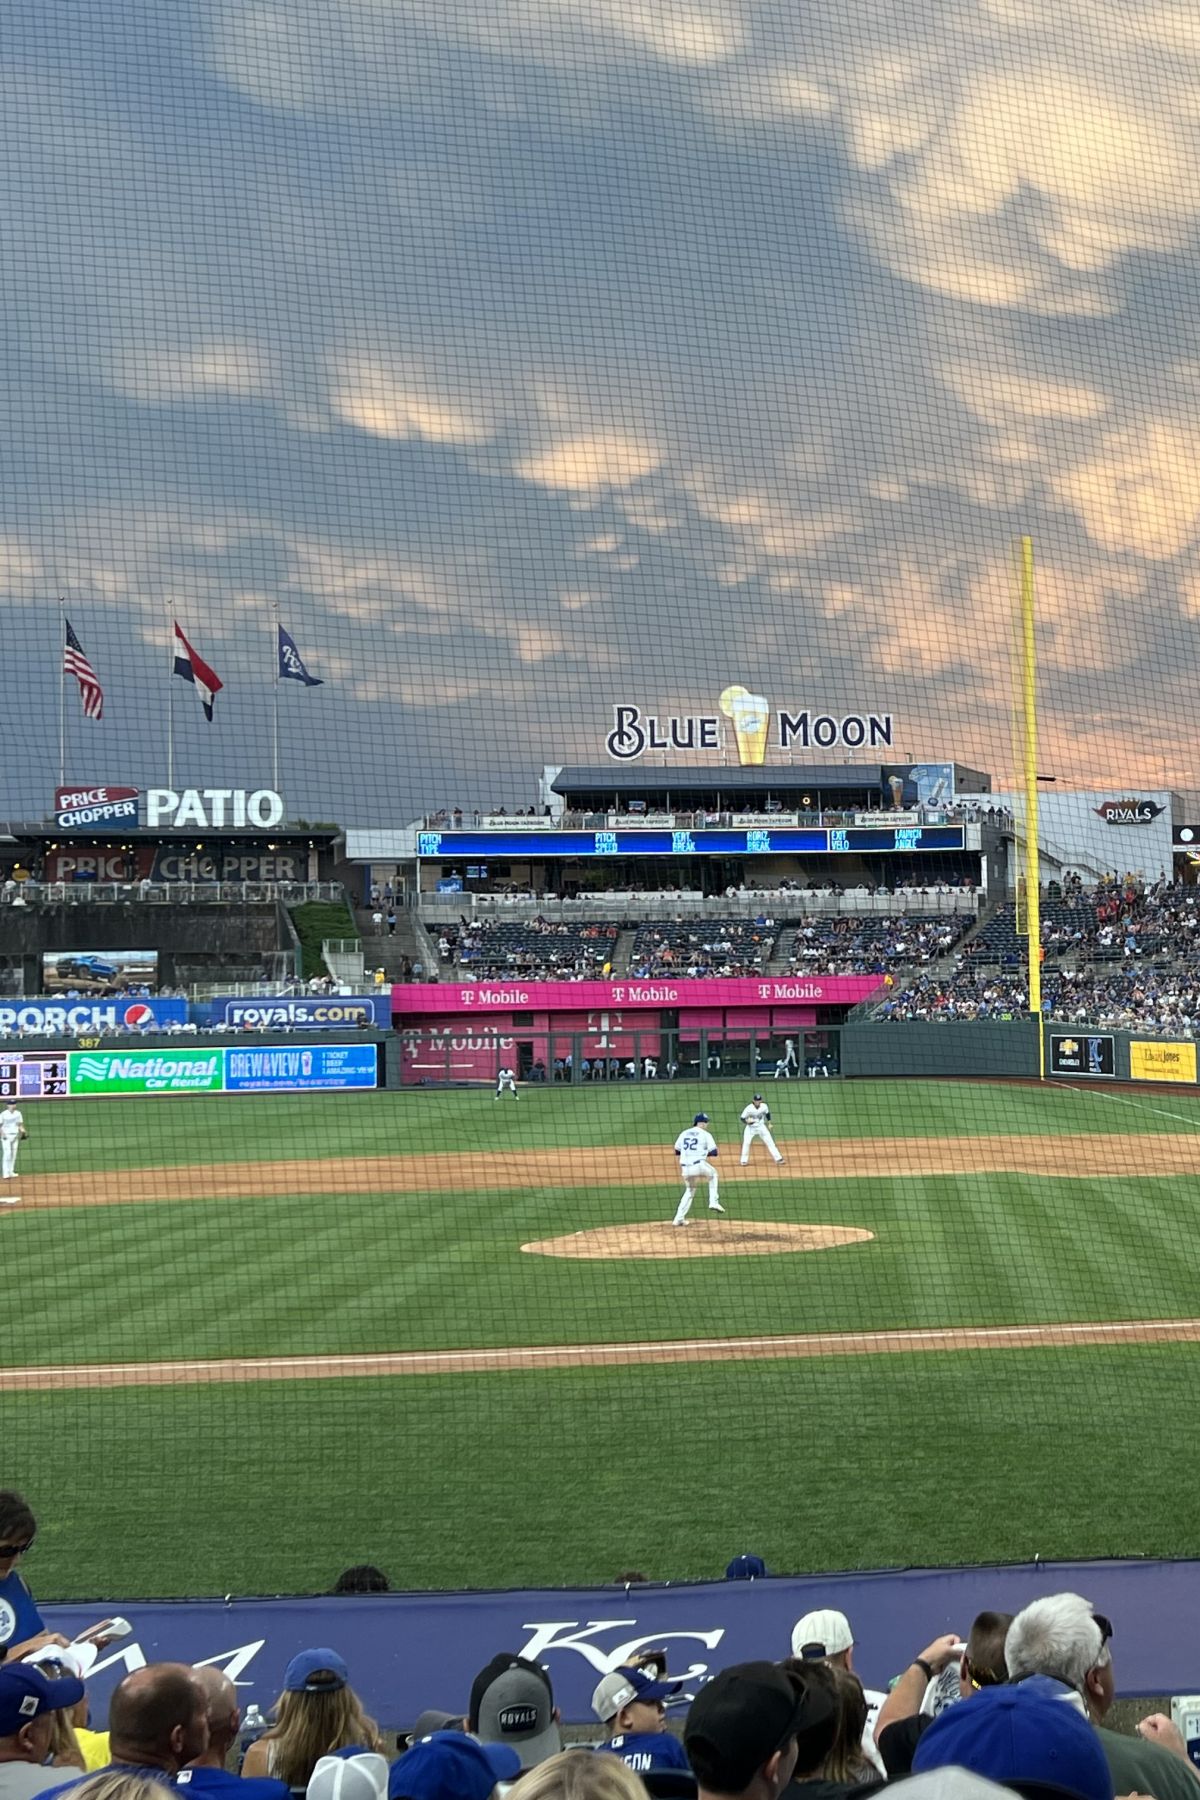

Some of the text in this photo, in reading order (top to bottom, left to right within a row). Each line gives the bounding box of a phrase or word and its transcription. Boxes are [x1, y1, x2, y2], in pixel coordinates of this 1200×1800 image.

[777, 709, 893, 750] MOON
[59, 789, 108, 809] PRICE
[147, 789, 284, 828] PATIO
[1106, 808, 1152, 820] RIVALS
[58, 803, 136, 828] CHOPPER
[420, 834, 442, 845] PITCH
[595, 833, 616, 844] PITCH
[831, 831, 847, 841] EXIT
[894, 829, 922, 840] LAUNCH
[420, 844, 439, 855] TYPE
[595, 843, 618, 853] SPEED
[672, 842, 695, 852] BREAK
[747, 841, 771, 851] BREAK
[831, 840, 849, 850] VELO
[894, 839, 917, 849] ANGLE
[57, 857, 296, 880] PRIC CHOPPER
[478, 989, 529, 1004] Mobile
[628, 986, 678, 1002] Mobile
[774, 983, 823, 999] Mobile
[0, 1006, 116, 1031] PORCH
[233, 1003, 367, 1029] royals.com
[429, 1028, 514, 1051] Mobile
[326, 1051, 349, 1059] TICKET
[108, 1056, 218, 1079] National
[326, 1059, 343, 1067] BEER
[146, 1077, 212, 1088] Car Rental
[683, 1137, 698, 1150] 52
[501, 1708, 537, 1725] ROYALS
